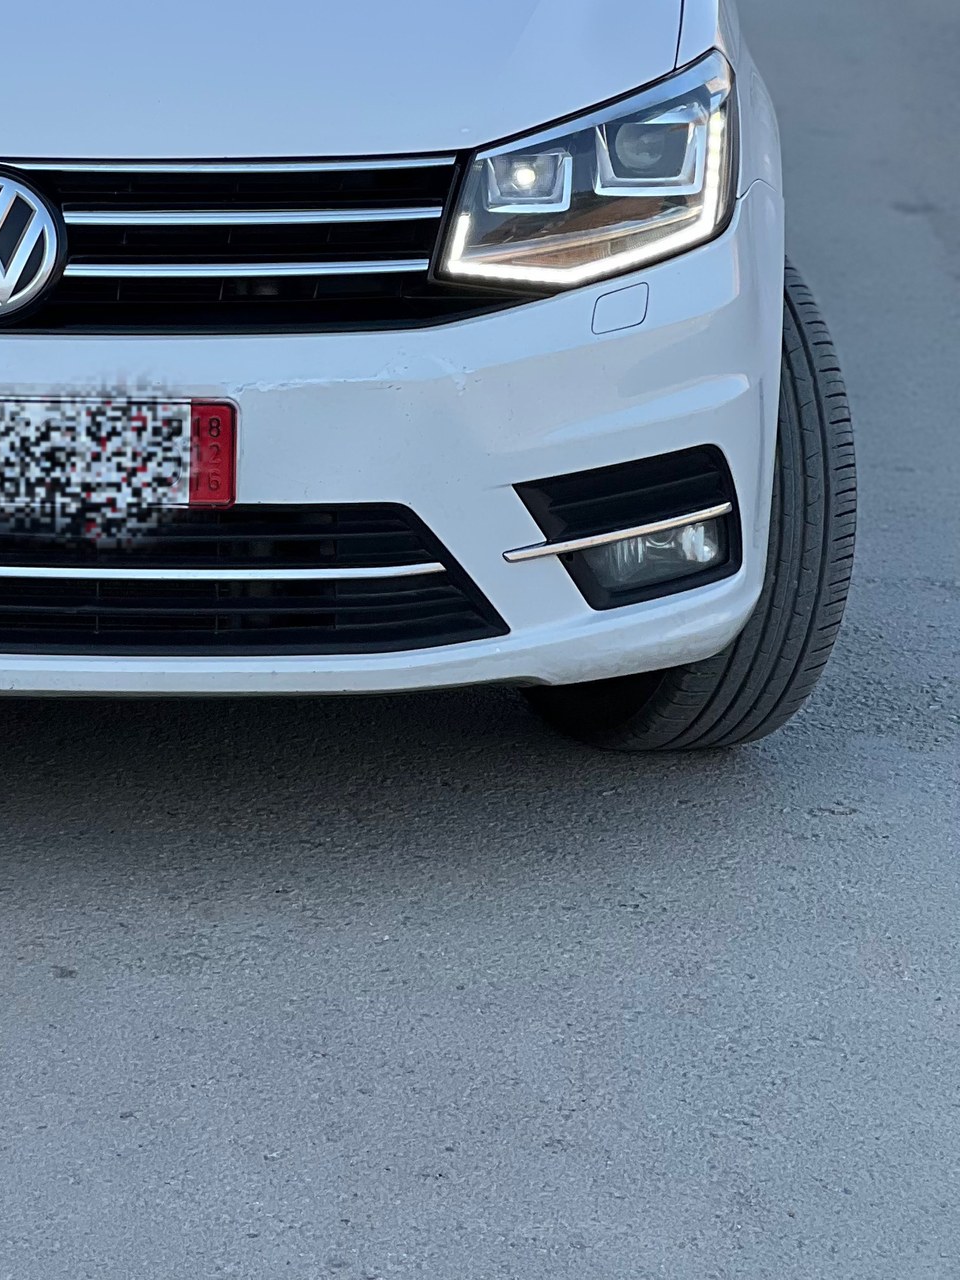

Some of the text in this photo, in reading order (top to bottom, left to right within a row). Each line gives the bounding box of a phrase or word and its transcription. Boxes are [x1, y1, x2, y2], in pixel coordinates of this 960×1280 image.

[192, 417, 222, 438] 18
[192, 443, 222, 465] 12
[192, 468, 222, 492] 16
